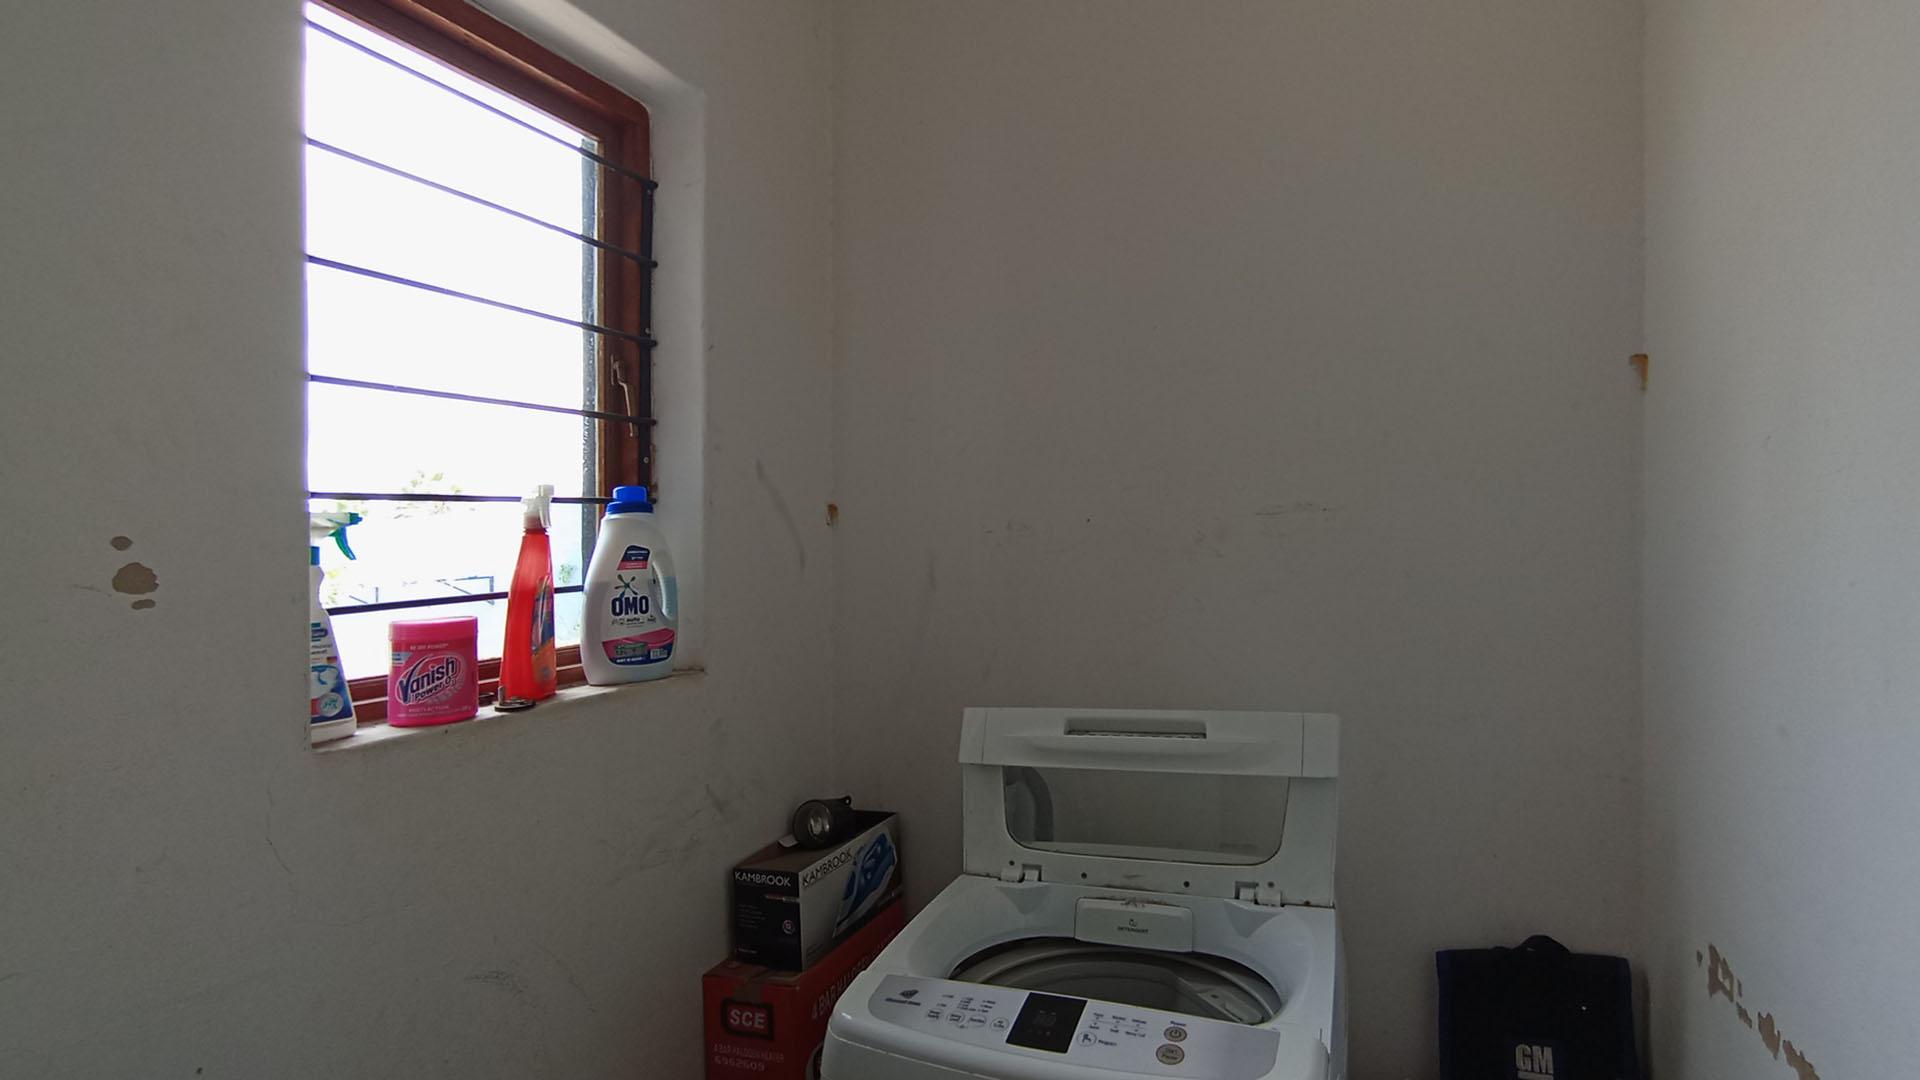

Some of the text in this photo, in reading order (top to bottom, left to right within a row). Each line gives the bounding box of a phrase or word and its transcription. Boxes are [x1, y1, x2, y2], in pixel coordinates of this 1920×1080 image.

[611, 595, 650, 617] OMO
[399, 656, 456, 704] Vanish
[414, 683, 445, 702] Power
[802, 848, 853, 887] KAMBROOK
[734, 871, 792, 887] KAMBROOK
[730, 1008, 766, 1029] SCE
[1515, 1044, 1554, 1074] GM
